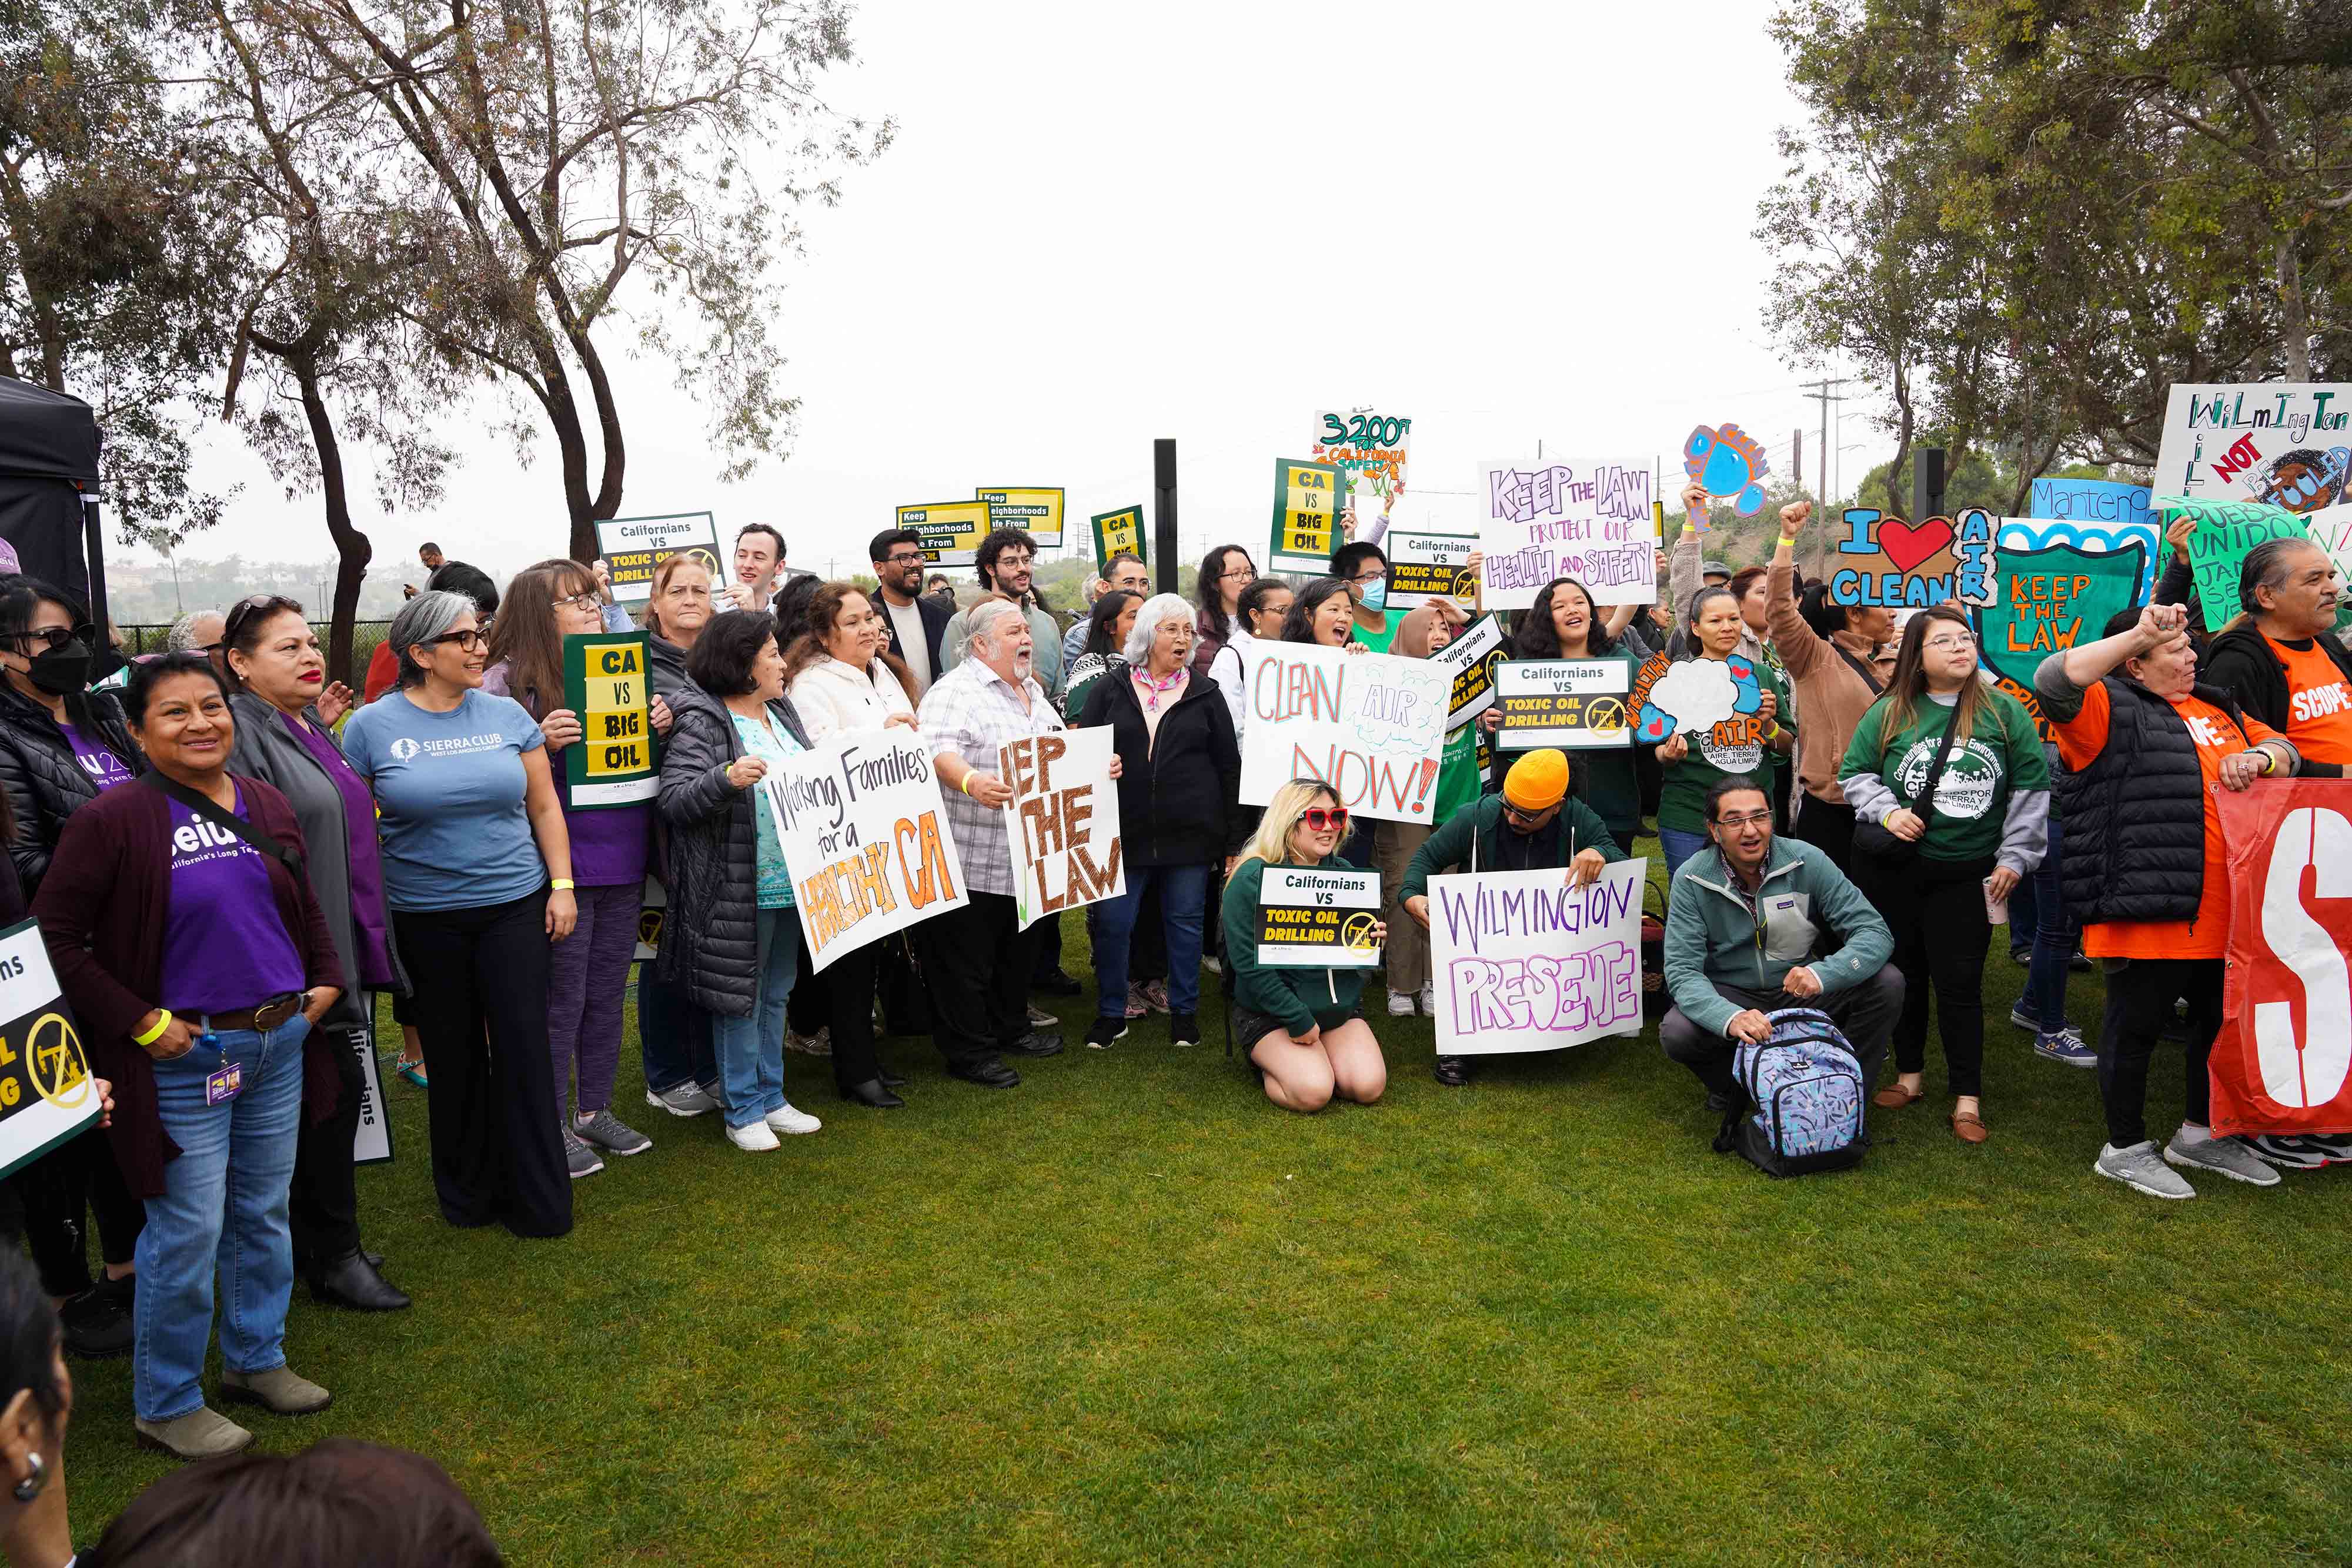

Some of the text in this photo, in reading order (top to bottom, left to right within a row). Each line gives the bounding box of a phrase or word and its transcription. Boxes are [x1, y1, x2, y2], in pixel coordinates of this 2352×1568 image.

[1355, 440, 1376, 450] FOR
[1329, 447, 1405, 464] CALIFORNIA
[2211, 431, 2262, 484] NOT
[1298, 472, 1325, 489] CA
[2243, 460, 2282, 497] BE
[984, 493, 1005, 502] Keep
[1305, 492, 1317, 508] VS
[1490, 466, 1650, 523] KEEP THE LAW
[903, 512, 926, 521] Keep
[991, 504, 1047, 515] eighborhoods
[620, 523, 691, 537] Californians
[1005, 519, 1027, 528] From
[1109, 517, 1129, 531] CA
[1297, 513, 1322, 529] BIG
[1116, 533, 1125, 545] VS
[1529, 519, 1634, 543] PROTECT OUR
[1838, 507, 1882, 555] I
[650, 537, 667, 547] VS
[928, 539, 953, 547] From
[1294, 533, 1320, 551] OIL
[1408, 540, 1471, 553] Californians
[0, 557, 14, 566] eiu
[612, 553, 652, 567] TOXIC
[1433, 554, 1448, 563] VS
[1960, 510, 1991, 601] AIR
[1395, 566, 1453, 579] TOXIC OIL
[1486, 541, 1653, 589] HEALTH AND SAFETY
[1392, 580, 1449, 592] DRILLING
[1830, 568, 1955, 608] CLEAN
[2010, 573, 2092, 603] KEEP
[2013, 602, 2068, 621] THE
[2007, 616, 2084, 653] LAW
[1438, 630, 1486, 664] alifornians
[601, 650, 637, 674] CA
[1460, 653, 1474, 668] VS
[1467, 664, 1484, 681] OIL
[1521, 667, 1604, 680] Californians
[613, 681, 631, 706] VS
[1255, 656, 1345, 724] CLEAN
[1448, 678, 1485, 712] RILLING
[1553, 681, 1572, 693] VS
[1625, 649, 1673, 730] HEALTHY
[1362, 684, 1417, 727] AIR
[1505, 697, 1582, 711] TOXIC OIL
[2292, 682, 2352, 721] SCOPE
[604, 713, 639, 740] BIG
[1505, 714, 1578, 727] DRILLING
[1713, 718, 1768, 747] AIR
[423, 733, 503, 751] SIERRA CLUB
[604, 744, 641, 769] OIL
[1893, 742, 1928, 781] Communities
[1925, 736, 1936, 749] for
[1937, 737, 1943, 747] a
[1967, 738, 2004, 779] Environment
[1291, 742, 1439, 814] NOW!
[771, 745, 928, 831] Working Families
[1944, 795, 1976, 804] TIERRA
[1952, 801, 1980, 811] LIMPIA
[172, 813, 238, 857] eiu
[1020, 783, 1093, 869] THE
[817, 823, 860, 861] for a
[171, 852, 216, 870] alifornia's
[216, 850, 238, 858] Long
[799, 810, 958, 954] HEALTHY CA
[1034, 836, 1122, 914] LAW
[1285, 875, 1365, 890] Californians
[1315, 892, 1334, 905] VS
[1266, 909, 1339, 924] TOXIC OIL
[1439, 876, 1635, 954] WILMINGTON
[1264, 927, 1335, 942] DRILLING
[1448, 940, 1638, 1036] PRESENTE
